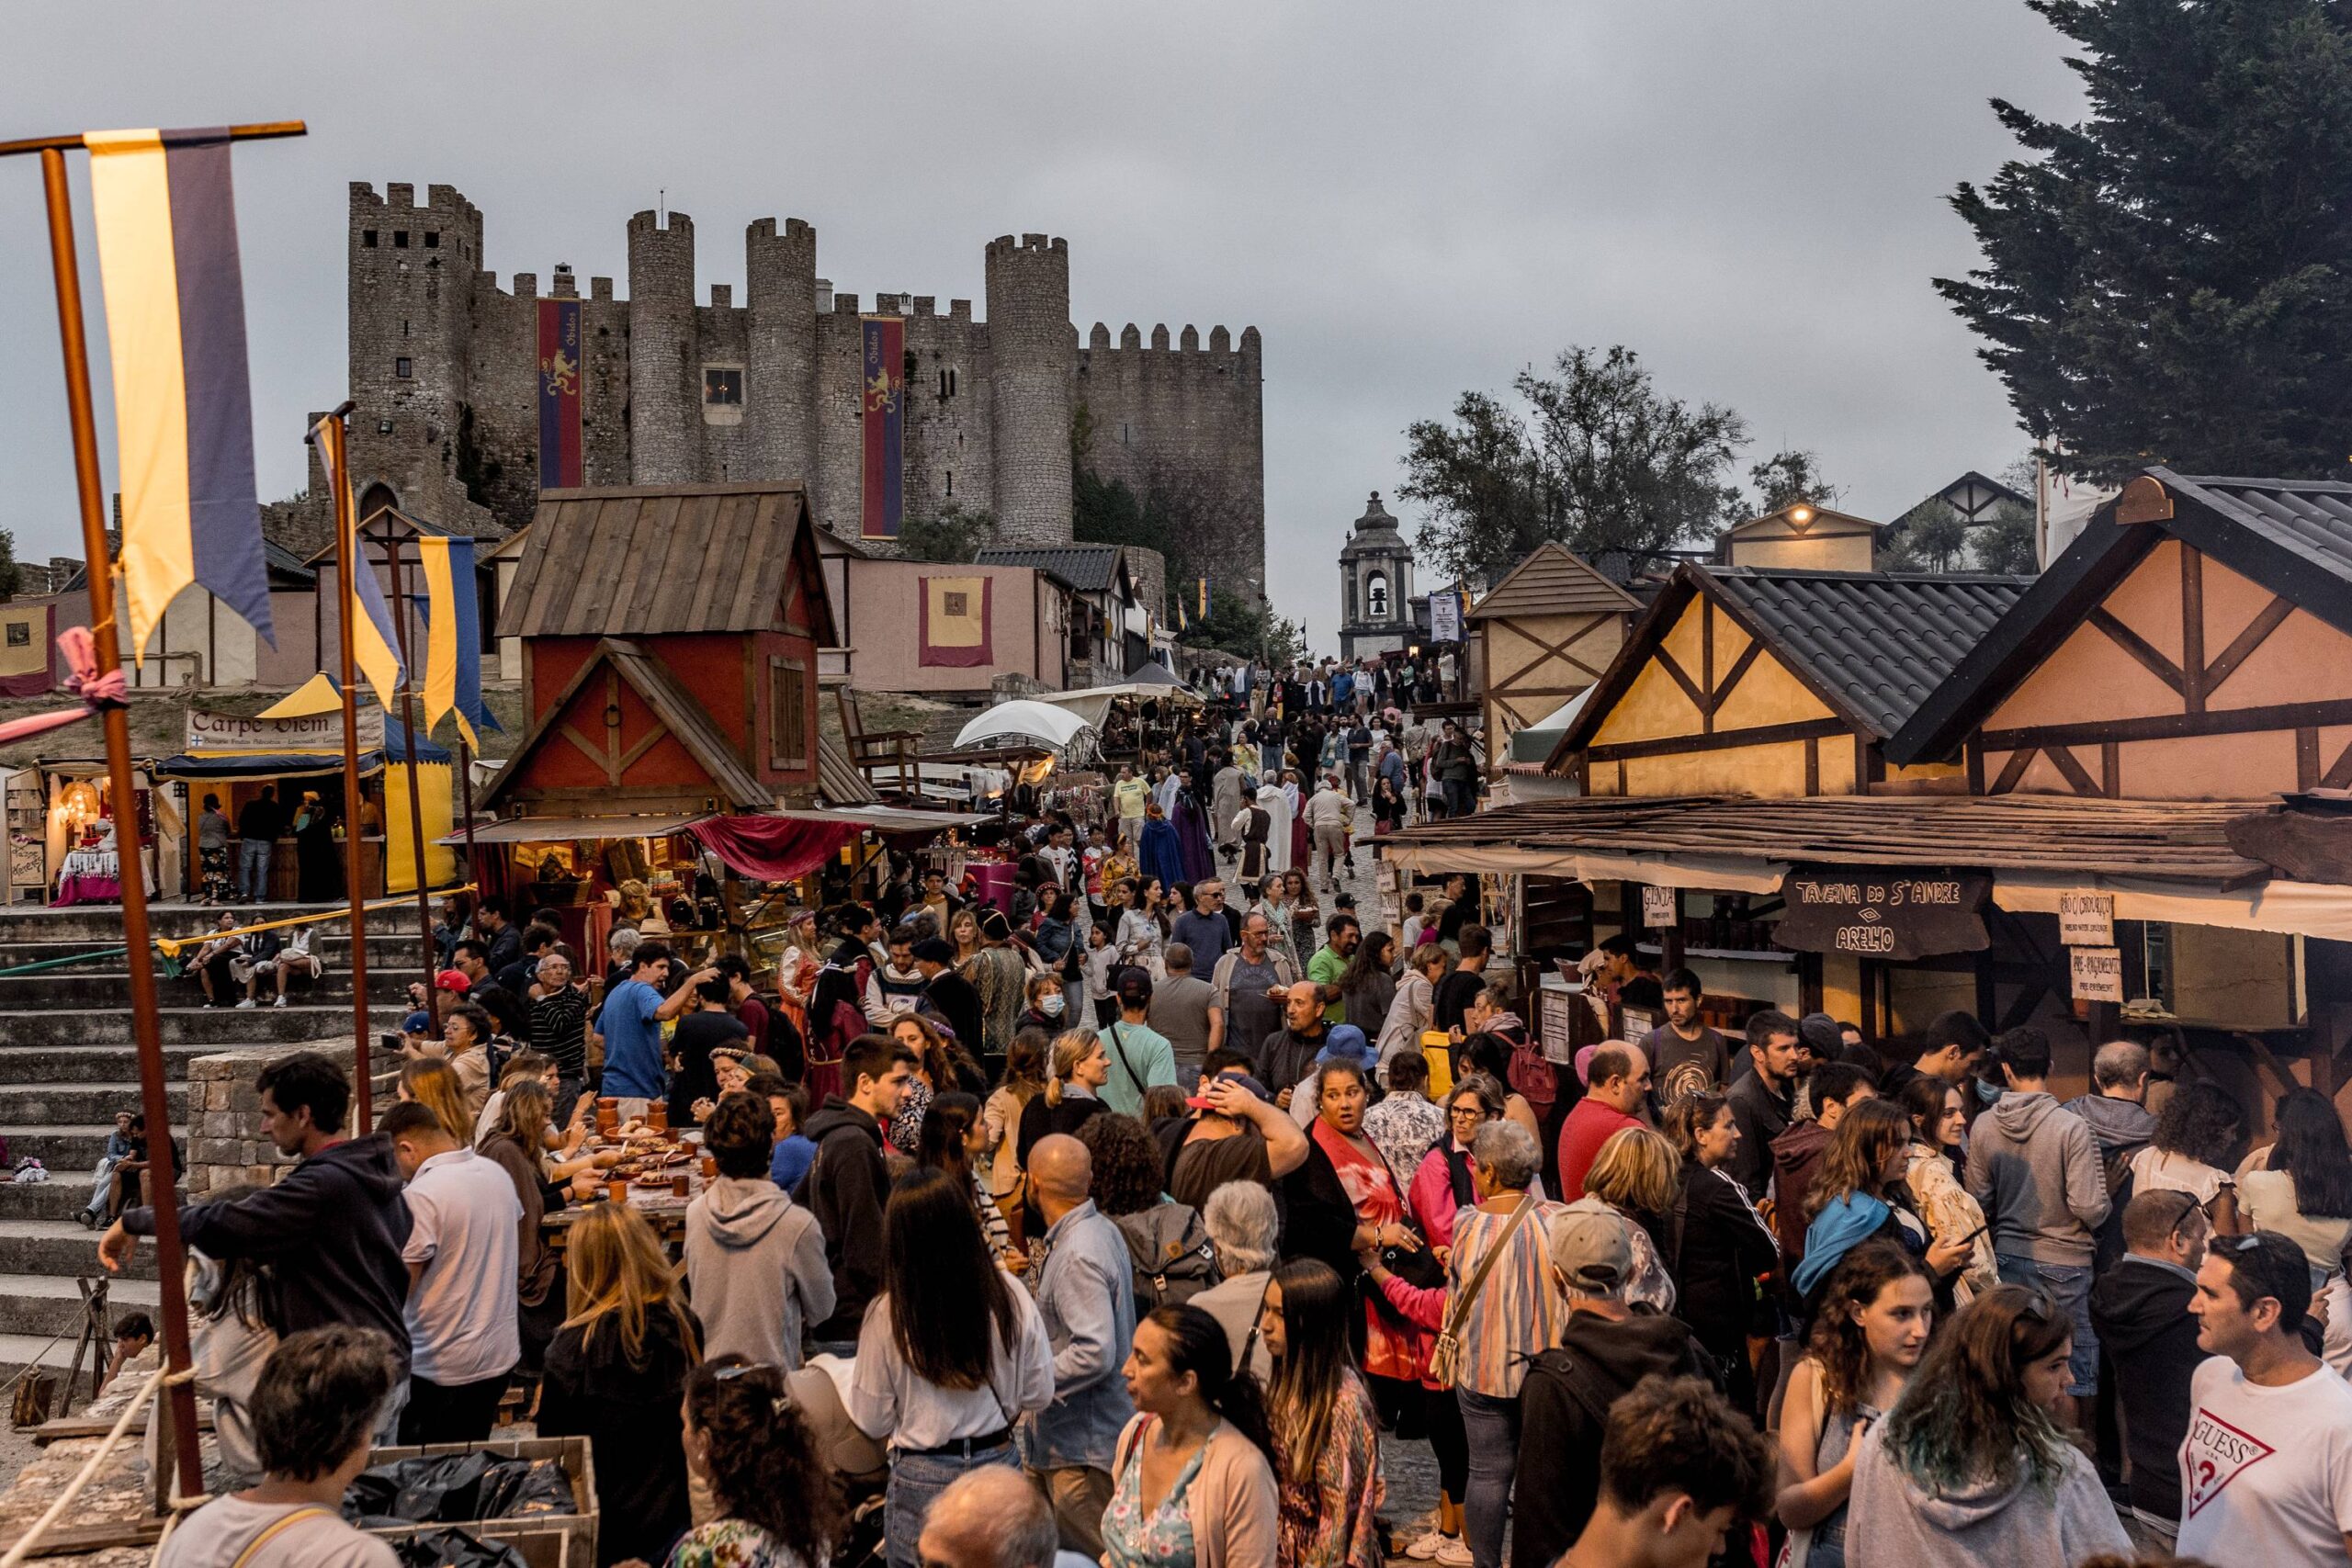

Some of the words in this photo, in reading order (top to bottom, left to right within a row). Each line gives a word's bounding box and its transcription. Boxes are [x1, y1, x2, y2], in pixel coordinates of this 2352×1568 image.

[192, 712, 263, 738] Carpe
[272, 717, 328, 733] Diem
[1796, 881, 1860, 904] TAVERNA
[1867, 886, 1885, 903] DO
[1911, 881, 1961, 904] ANDRE
[1837, 926, 1894, 953] ARELHO
[2193, 1420, 2249, 1465] GUESS
